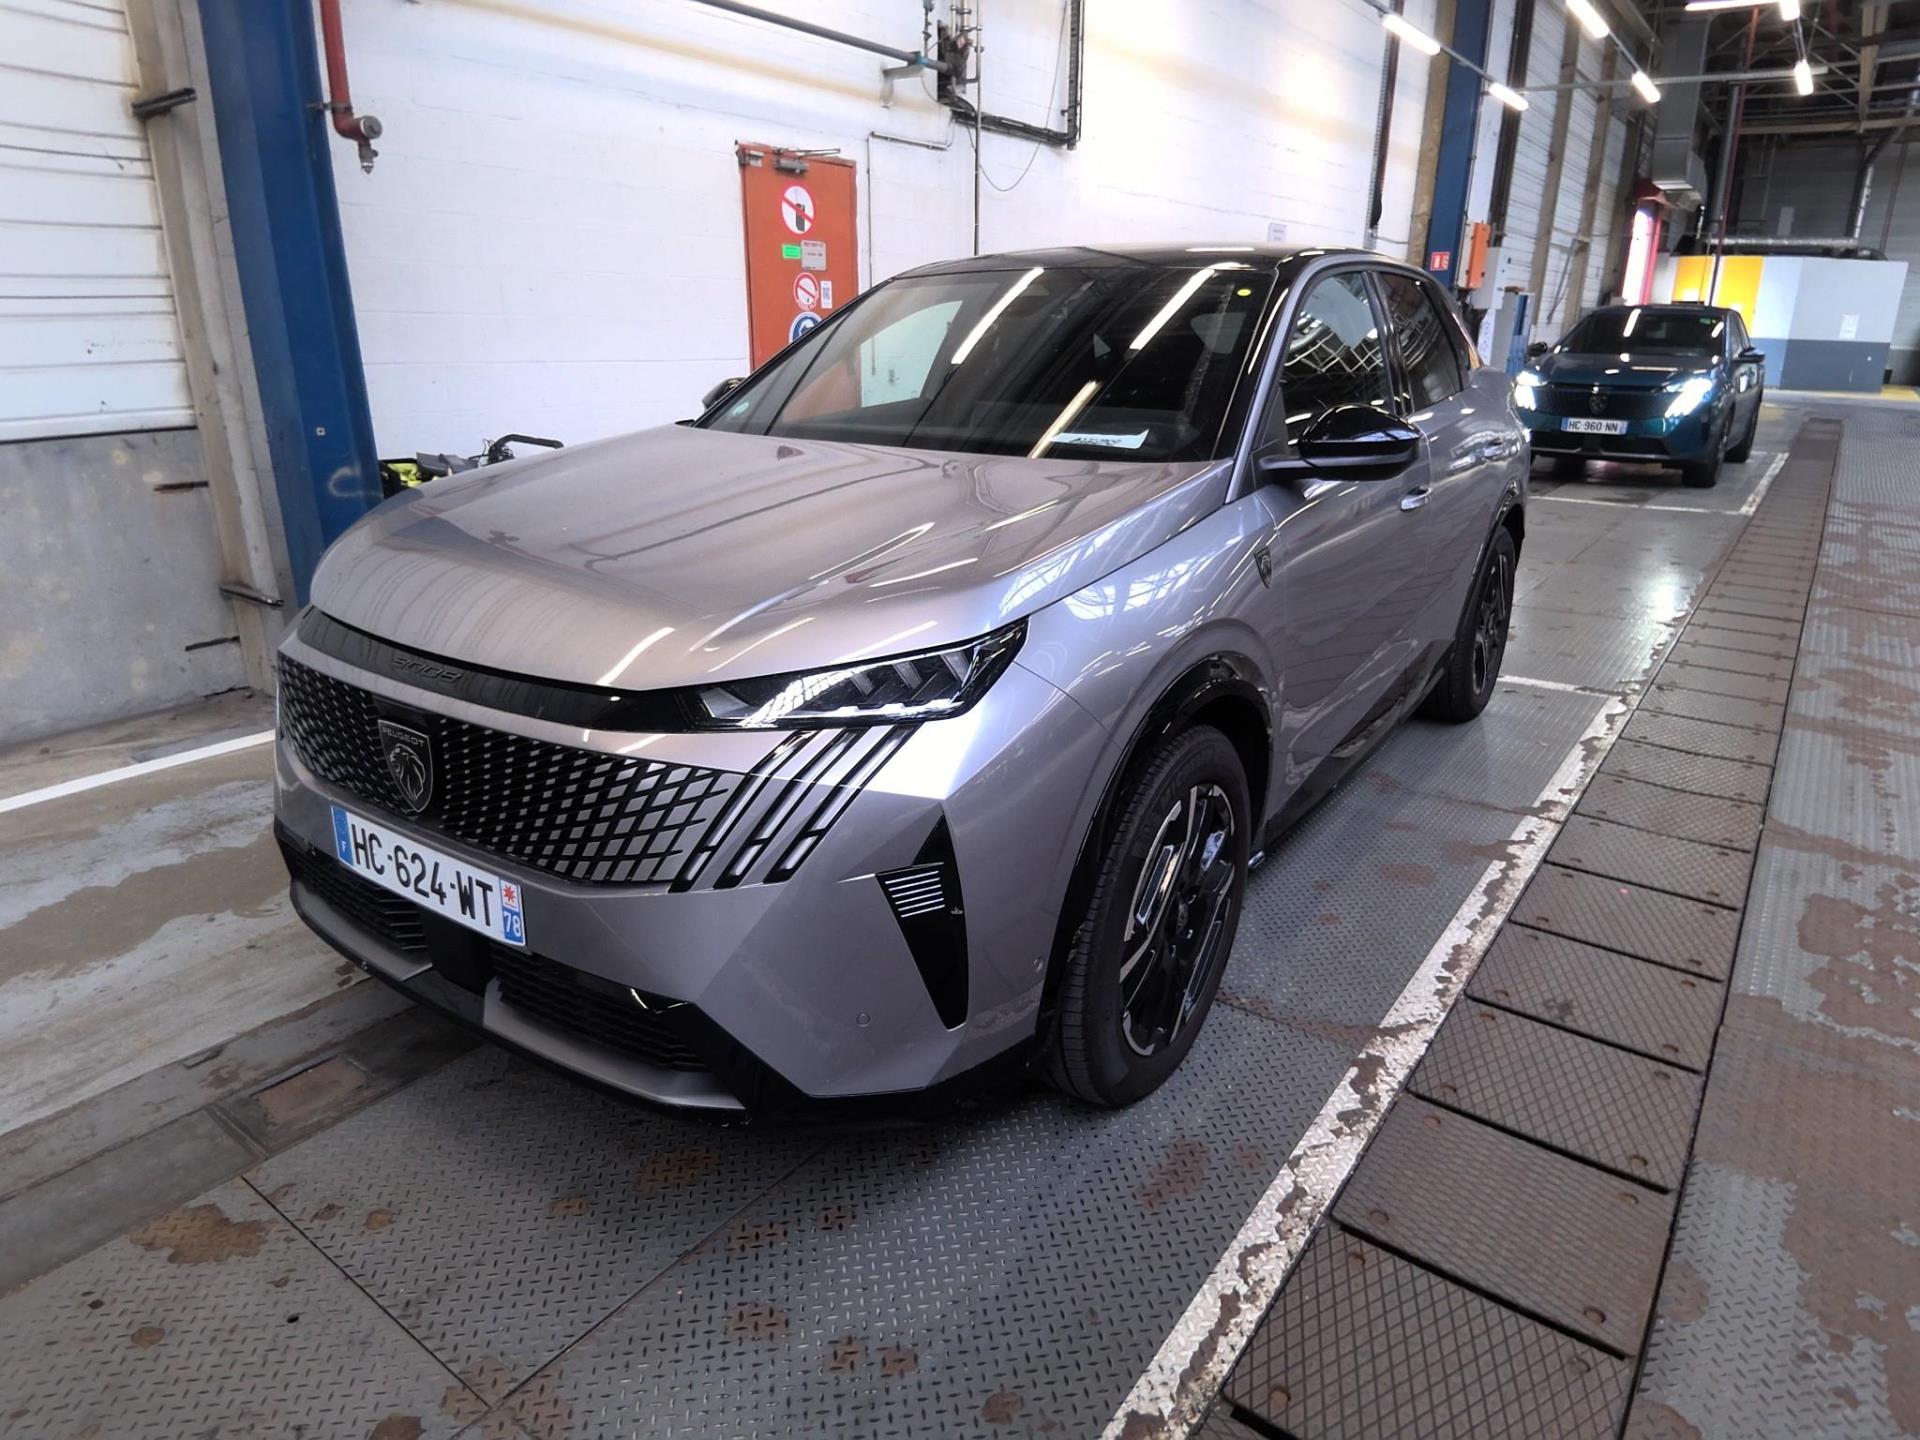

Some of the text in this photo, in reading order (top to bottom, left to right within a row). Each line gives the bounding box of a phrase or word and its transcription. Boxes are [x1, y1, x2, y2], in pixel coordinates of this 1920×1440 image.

[382, 726, 425, 748] PEUGEOT
[351, 823, 493, 927] HC-624-WT
[503, 911, 522, 937] 78
